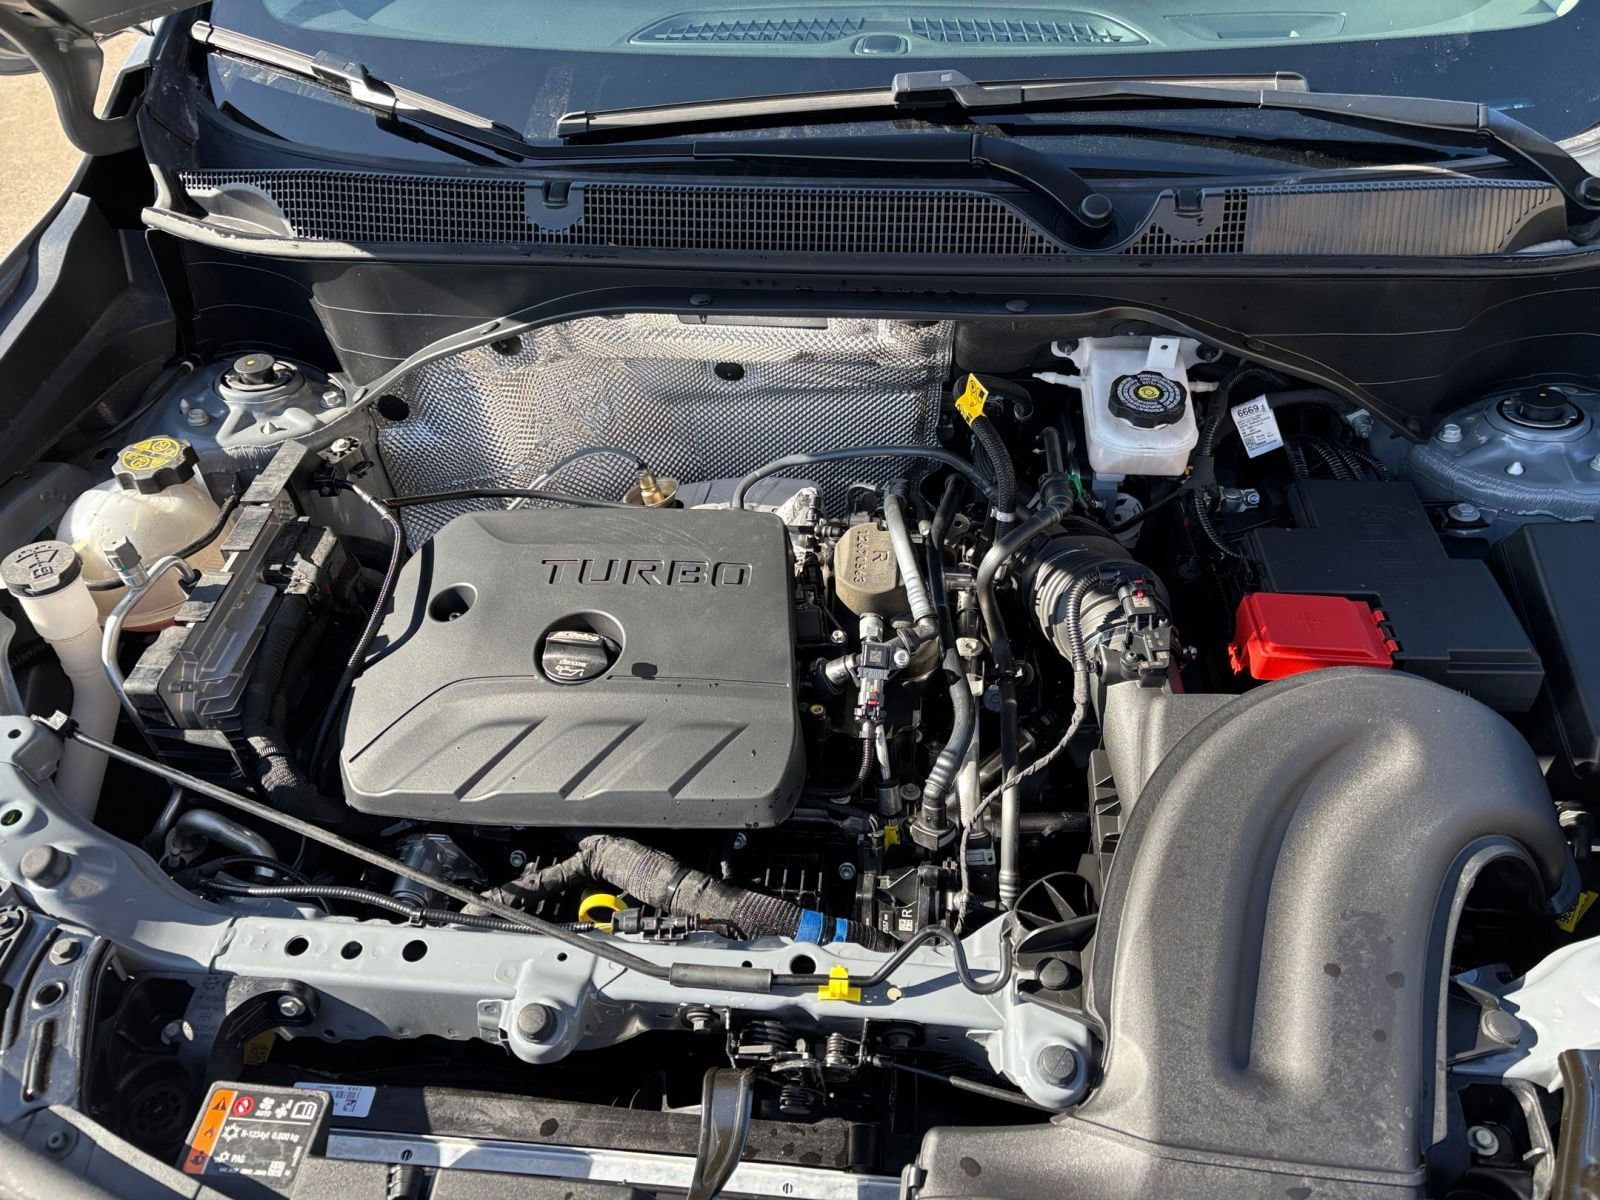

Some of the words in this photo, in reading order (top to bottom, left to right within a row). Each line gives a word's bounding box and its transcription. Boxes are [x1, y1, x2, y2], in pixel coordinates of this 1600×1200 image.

[1237, 404, 1259, 417] 6669
[872, 550, 889, 562] R
[541, 559, 752, 586] TURBO
[901, 909, 913, 918] R
[254, 1109, 272, 1117] AUTO
[290, 1133, 300, 1143] kg
[230, 1154, 246, 1163] PAG
